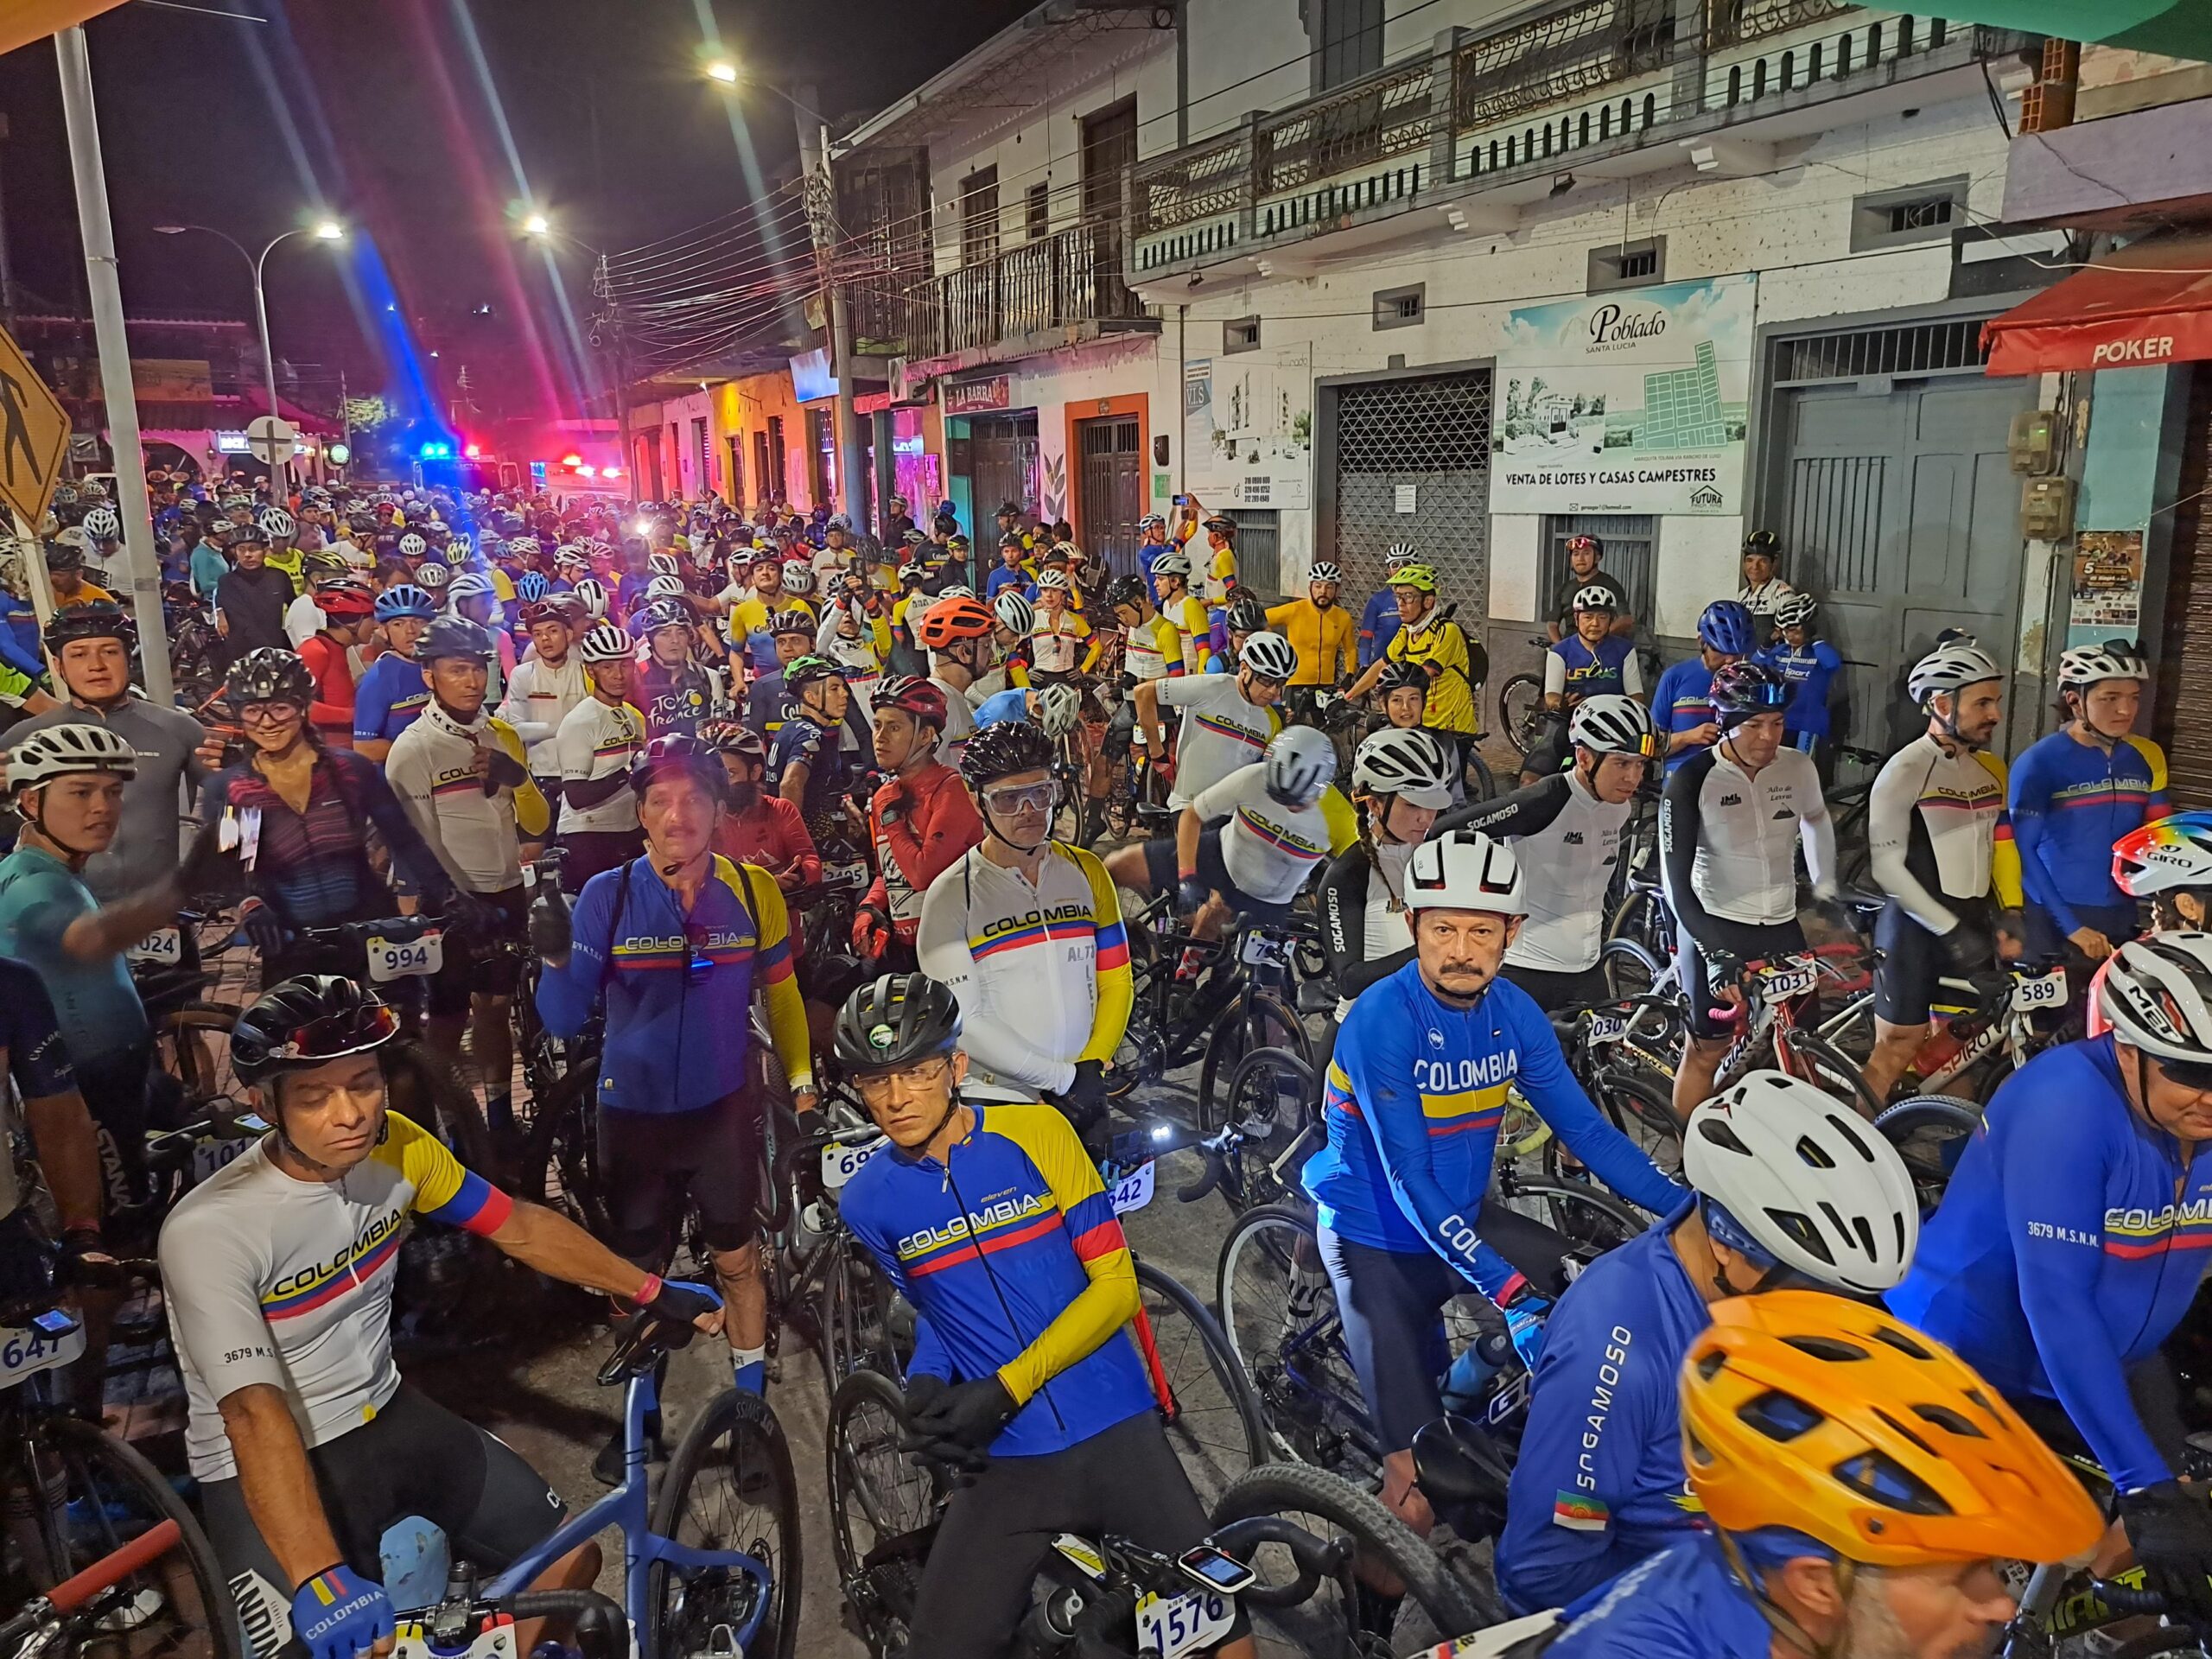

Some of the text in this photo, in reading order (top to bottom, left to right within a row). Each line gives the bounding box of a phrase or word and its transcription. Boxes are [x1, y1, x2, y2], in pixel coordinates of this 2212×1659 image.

[1590, 304, 1666, 344] Poblado
[1586, 342, 1637, 354] SANTA LUCIA
[2093, 336, 2173, 364] POKER
[956, 385, 994, 407] LA BARRA
[1506, 468, 1716, 485] VENTA DE LOTES Y CASAS CAMPESTRES
[1691, 493, 1722, 505] FUTURA
[1216, 715, 1267, 741] COLOMBIA
[1937, 784, 1998, 799] COLOMBIA
[2066, 777, 2150, 794] COLOMBIA
[1248, 810, 1316, 849] COLOMBIA
[1467, 803, 1519, 832] SOGAMOSO
[1664, 798, 1673, 853] SOGAMOSO
[2146, 851, 2192, 868] GIRO
[983, 904, 1093, 938] COLOMBIA
[1327, 887, 1346, 953] SOGAMOSO
[625, 932, 741, 950] COLOBIA
[385, 946, 428, 969] 994
[1769, 969, 1810, 994] 1031
[2022, 982, 2055, 1002] 589
[2129, 985, 2179, 1037] MET
[1943, 1032, 1992, 1079] SPIRO
[1414, 1048, 1518, 1092] COLOMBIA
[980, 1185, 1018, 1204] eleven
[898, 1192, 1042, 1255] COLOMBIA
[2104, 1198, 2212, 1230] COLOM
[1438, 1214, 1483, 1264] COL
[2027, 1221, 2100, 1248] 3679 M.S.N.M.
[274, 1208, 402, 1297] COLOMBIA
[224, 1347, 252, 1363] 3679
[1576, 1325, 1631, 1491] SOGAMOSO
[304, 1590, 384, 1641] COLOMBIA
[1151, 1592, 1224, 1656] 1576
